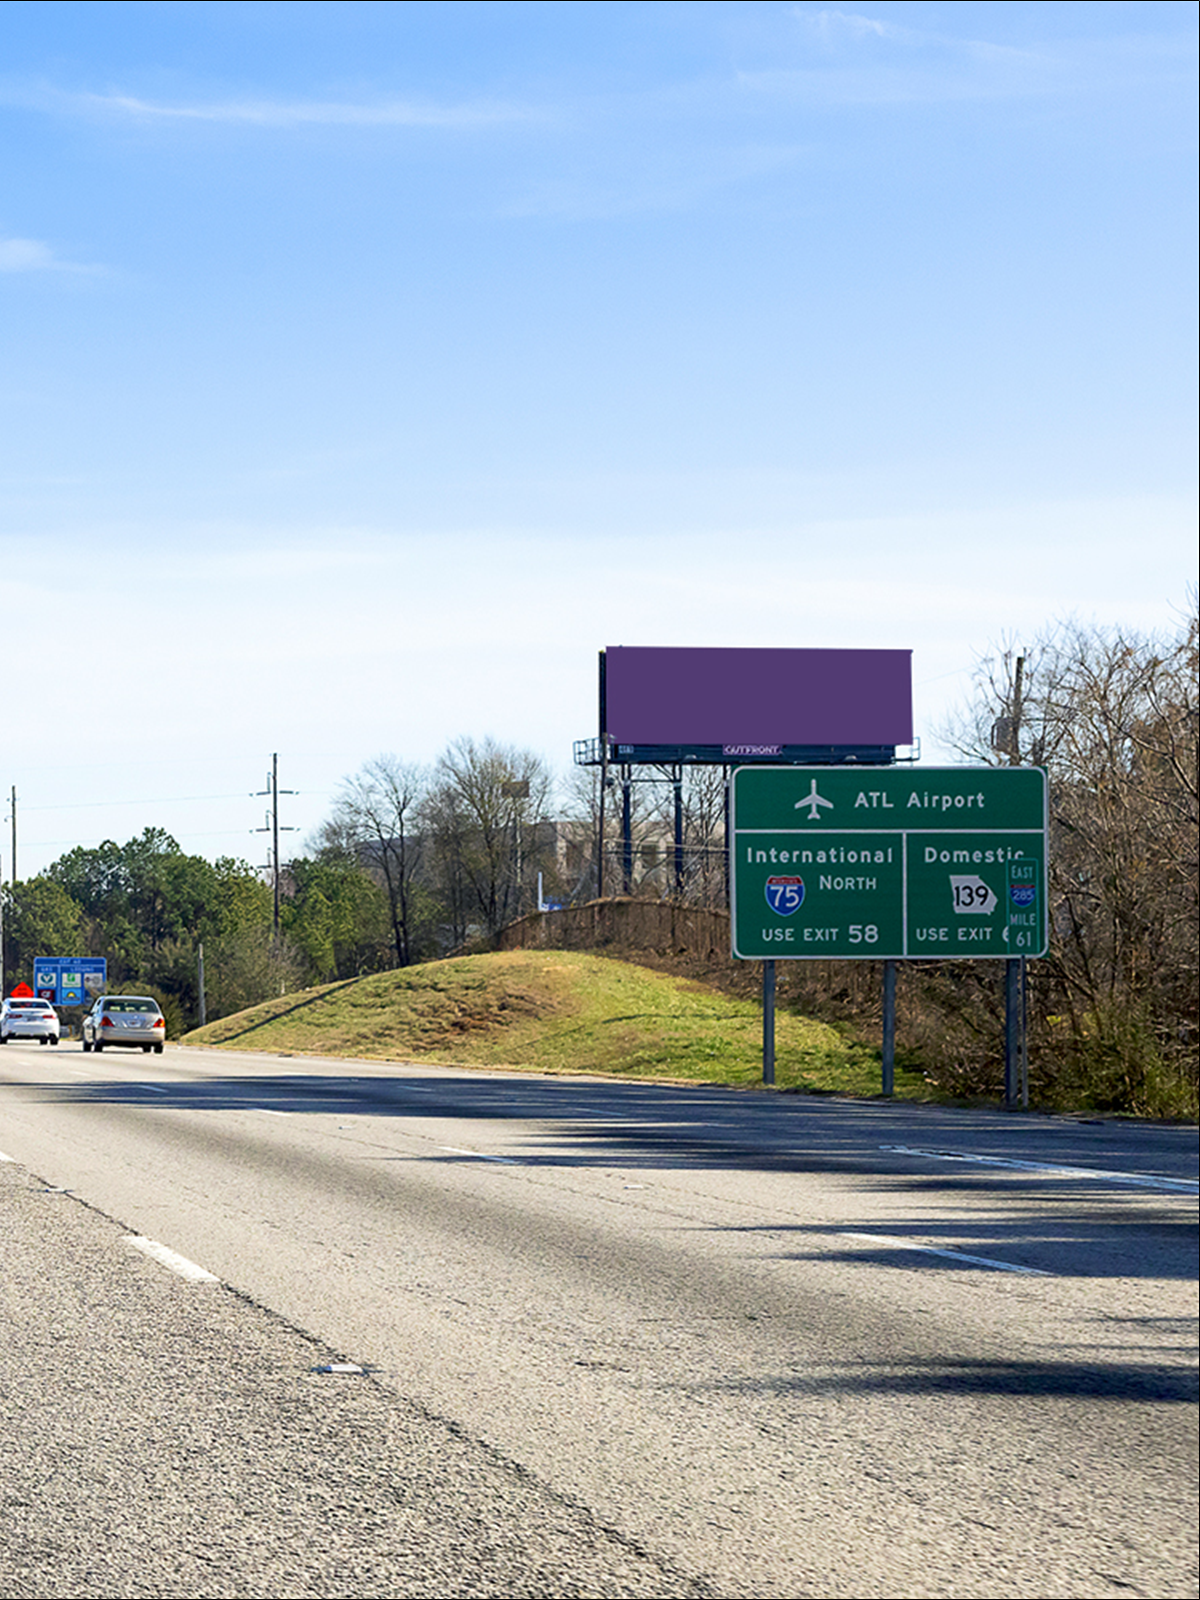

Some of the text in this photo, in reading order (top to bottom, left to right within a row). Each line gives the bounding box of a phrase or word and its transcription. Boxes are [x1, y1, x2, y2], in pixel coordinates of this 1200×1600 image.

[854, 792, 985, 811] ATL Airport
[747, 847, 893, 863] International
[924, 846, 1024, 863] Domestic
[1011, 865, 1033, 879] EAST
[819, 874, 877, 890] NORTH
[769, 886, 800, 907] 75
[954, 885, 989, 907] 139
[1012, 889, 1035, 901] 285
[1010, 913, 1036, 926] MILE
[762, 924, 879, 944] USE EXIT 58
[915, 927, 949, 941] USE
[957, 927, 993, 941] EXIT
[1016, 931, 1032, 947] 61
